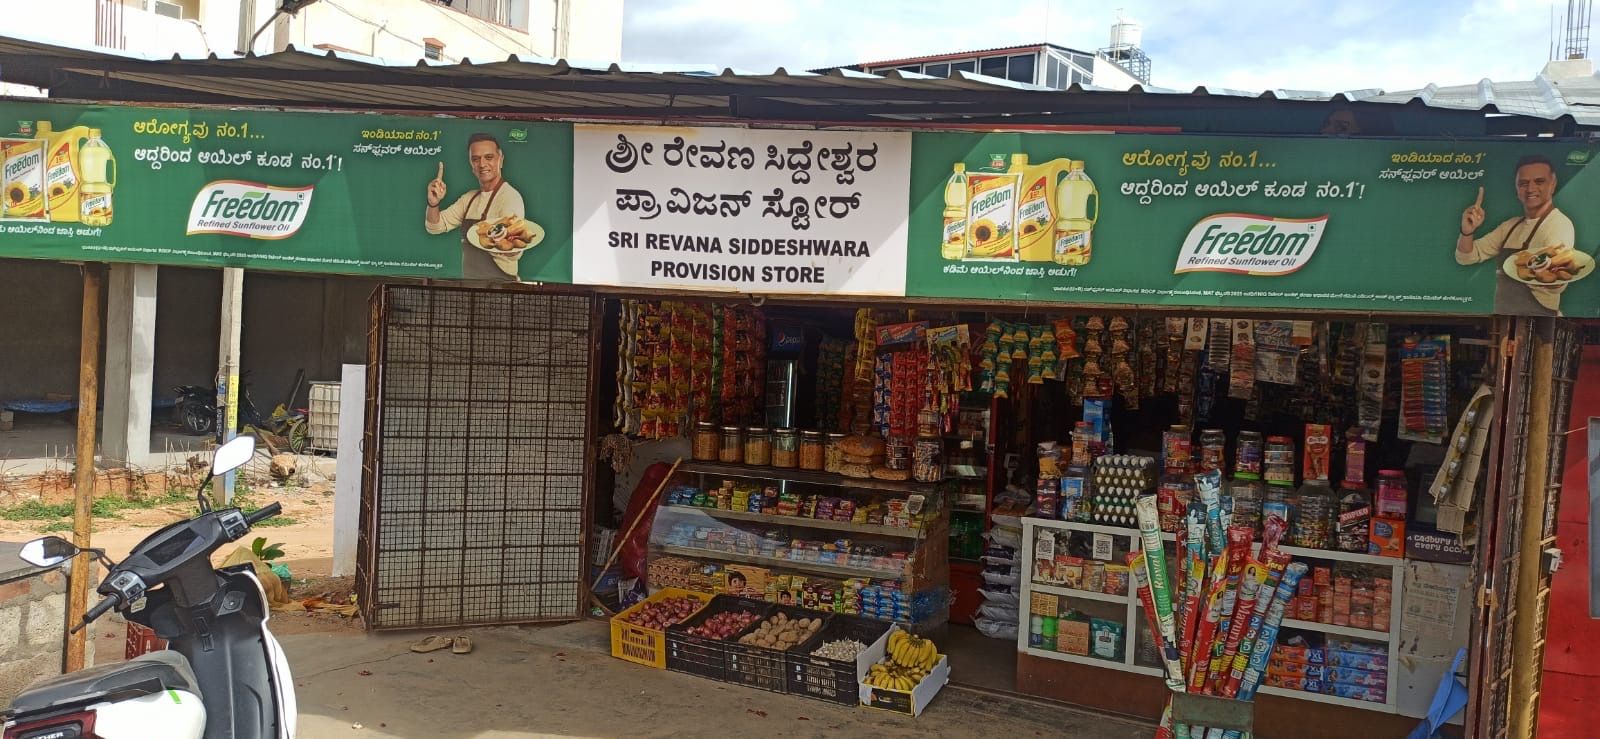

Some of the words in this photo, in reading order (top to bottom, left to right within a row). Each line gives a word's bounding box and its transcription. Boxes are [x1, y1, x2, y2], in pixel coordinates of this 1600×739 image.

[133, 120, 209, 144] ಆರೋಗ್ಯವು
[5, 153, 40, 179] Freedom
[134, 146, 193, 170] ಆದ್ದರಿಂದ
[198, 149, 252, 167] ಆಯಿಲ್
[256, 151, 294, 168] ಕೂಡ
[605, 133, 654, 173] ಶ್ರೀ
[663, 136, 755, 171] ರೇವಣ
[1122, 150, 1211, 176] ಆರೋಗ್ಯವು
[615, 187, 753, 220] ಪ್ರಾವಿಜನ್
[971, 189, 1011, 217] Freedom
[1120, 179, 1188, 205] ಆದ್ದರಿಂದ
[1194, 180, 1260, 198] ಆಯಿಲ್
[1264, 182, 1308, 198] ಕೂಡ
[201, 189, 299, 222] Freedom
[197, 219, 231, 230] Refined
[232, 221, 275, 232] Sunflower
[276, 222, 291, 232] Oil
[608, 231, 639, 249] SRI
[645, 233, 723, 254] REVANA
[728, 237, 871, 258] SIDDESHWARA
[1193, 224, 1309, 256] Freedom
[651, 260, 755, 283] PROVISION
[761, 265, 825, 284] STORE
[1187, 256, 1227, 266] Refined
[1228, 256, 1280, 267] Sunflower
[1280, 257, 1297, 267] Oil
